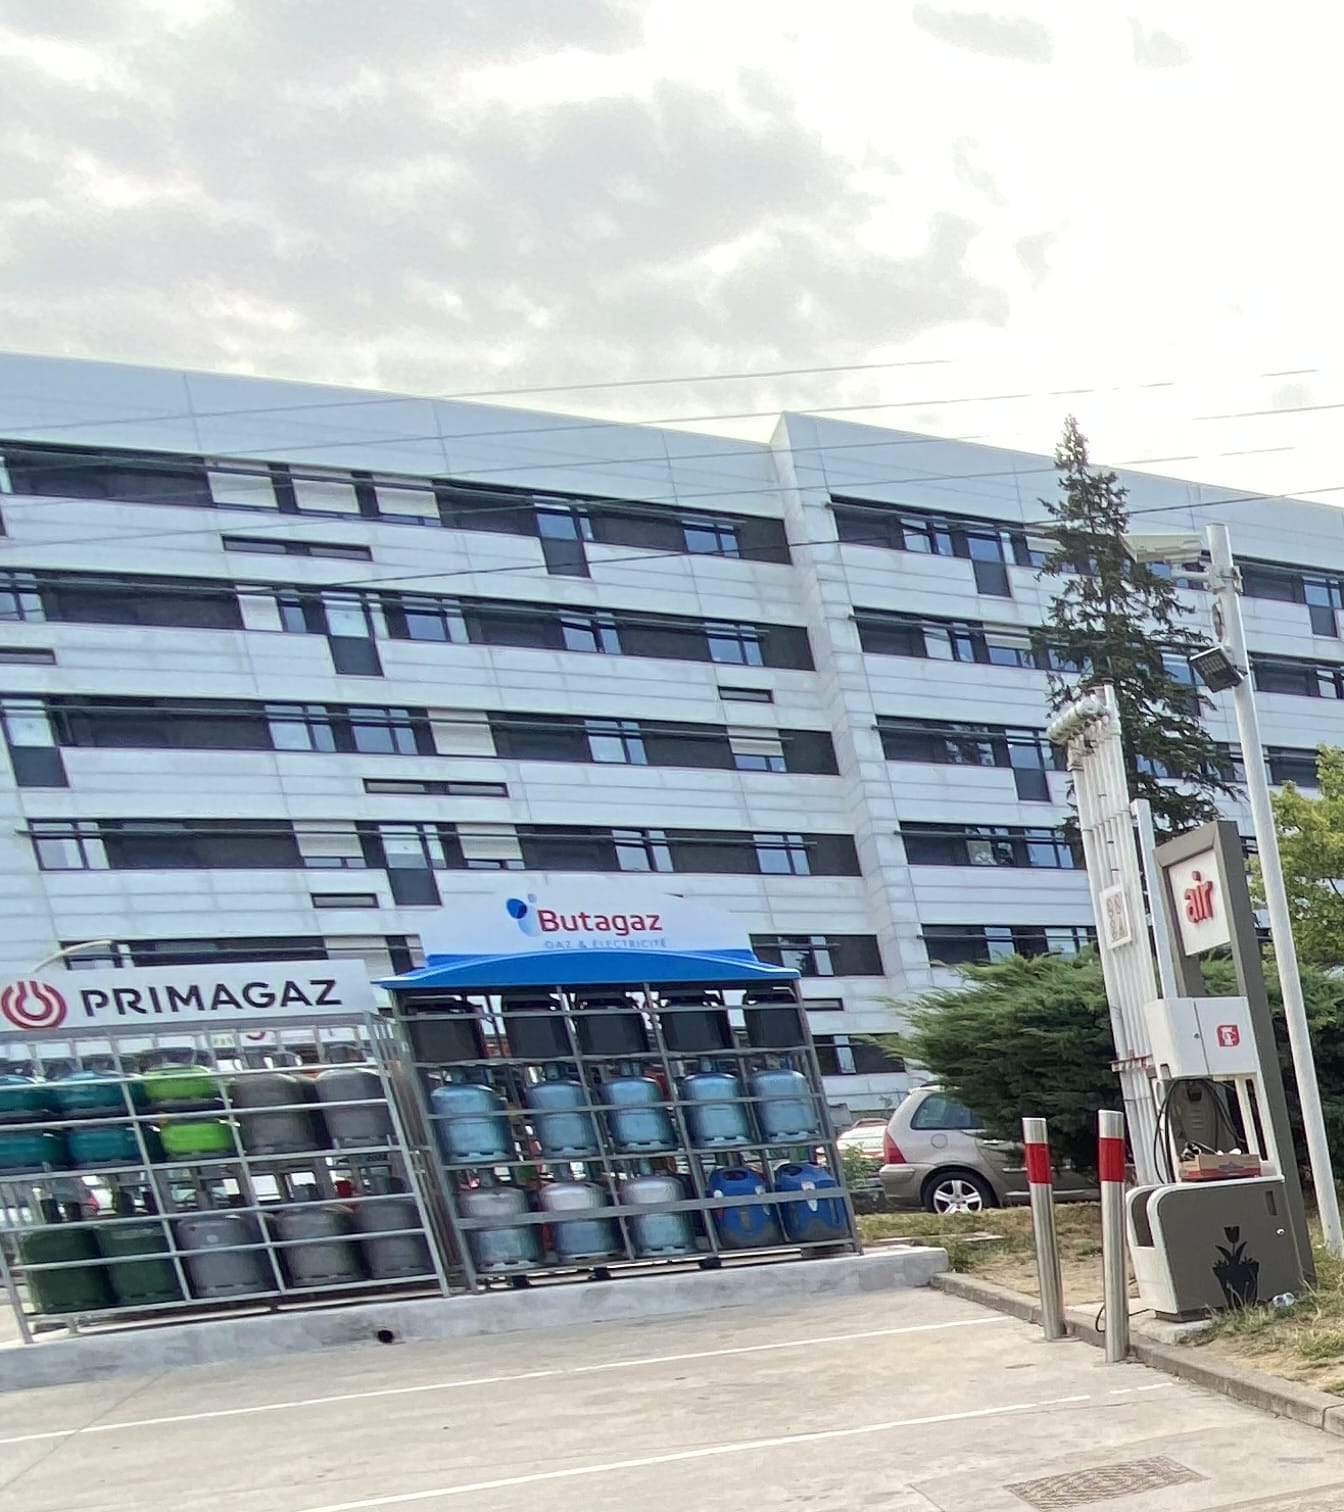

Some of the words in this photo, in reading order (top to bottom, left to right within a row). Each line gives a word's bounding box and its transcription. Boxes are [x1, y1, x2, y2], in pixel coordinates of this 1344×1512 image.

[1184, 871, 1214, 923] air
[537, 909, 663, 936] Butagaz
[79, 979, 343, 1017] PRIMAGAZ
